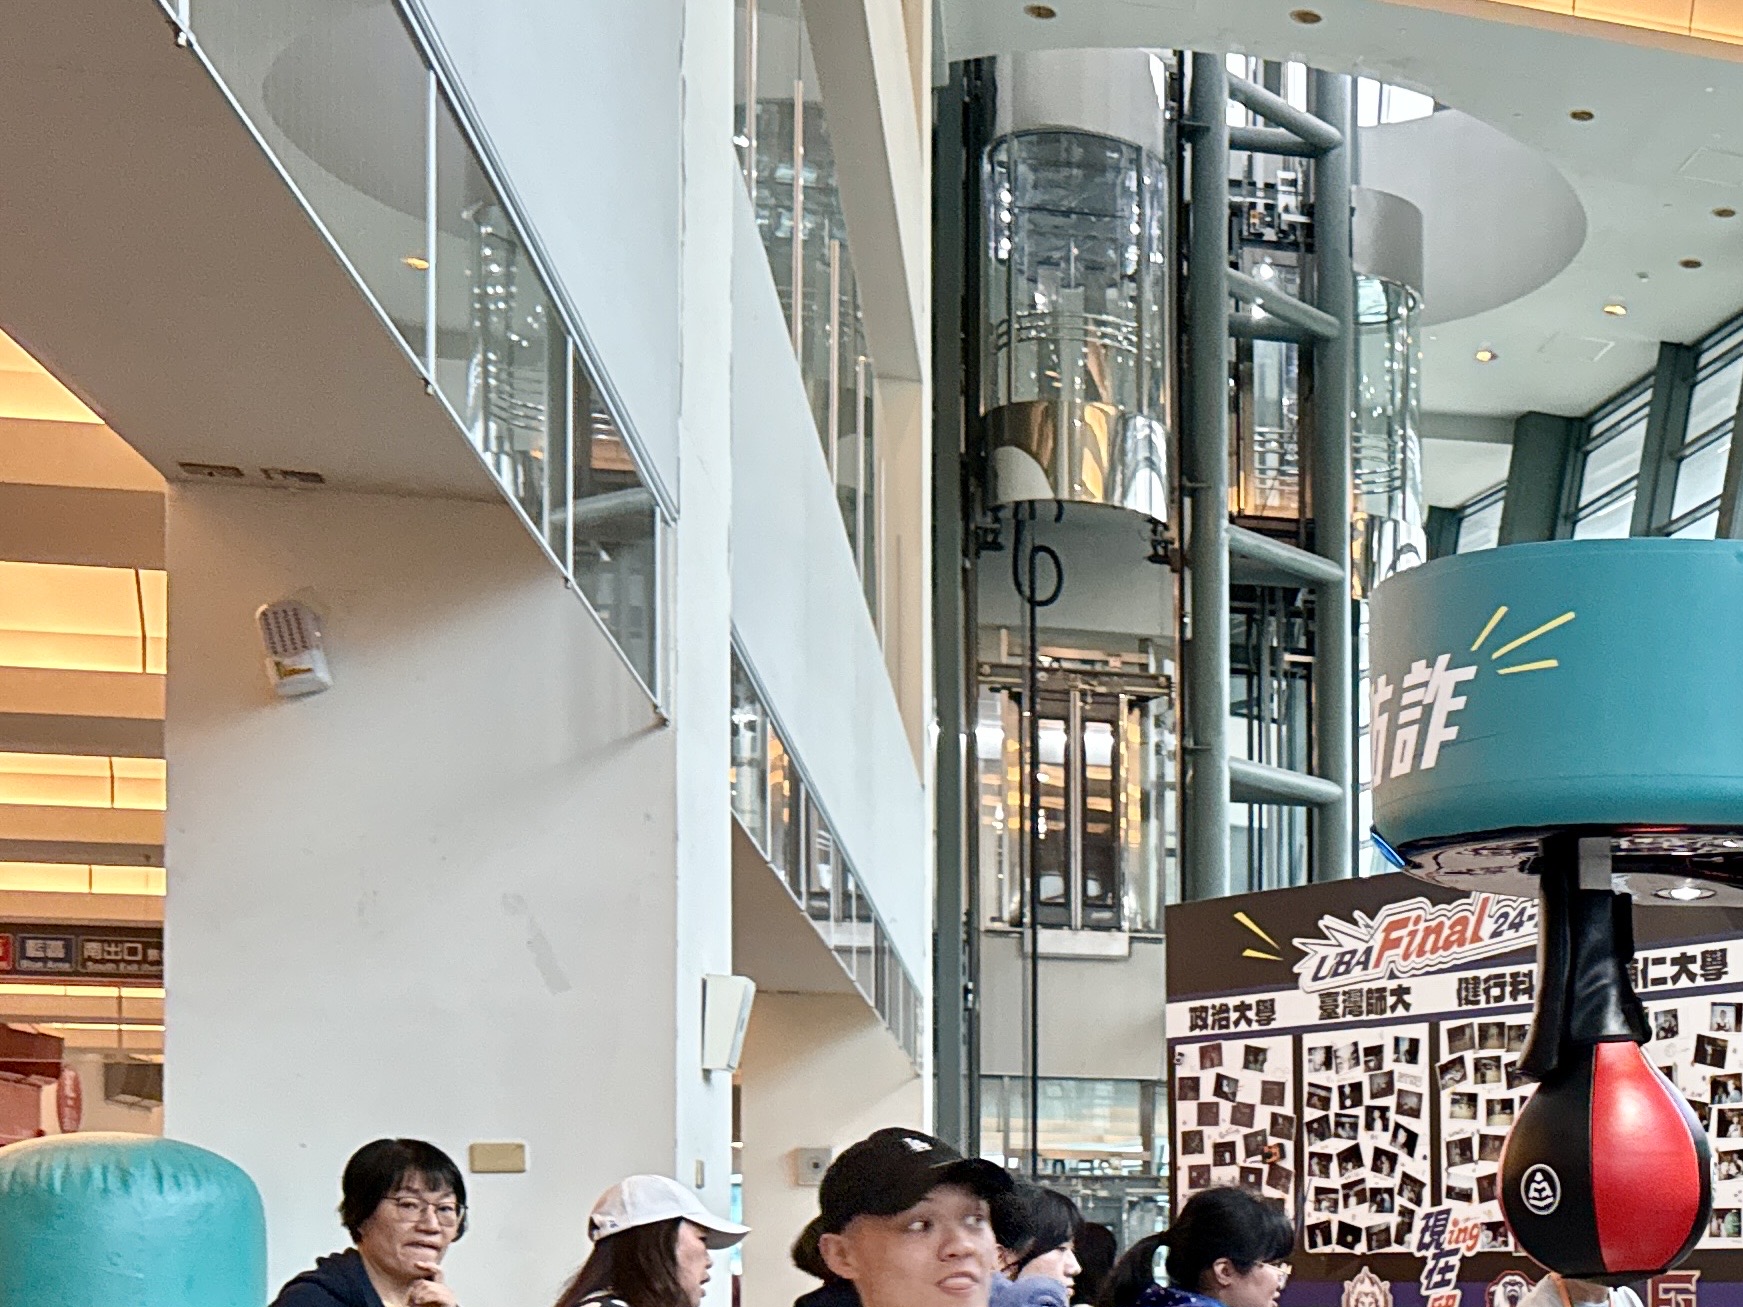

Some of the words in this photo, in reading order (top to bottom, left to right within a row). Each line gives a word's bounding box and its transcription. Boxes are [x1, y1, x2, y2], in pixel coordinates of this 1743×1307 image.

[1372, 895, 1491, 971] Final
[1488, 905, 1540, 941] 24-
[1188, 998, 1277, 1033] 政治大學
[1318, 985, 1412, 1021] 臺灣師大
